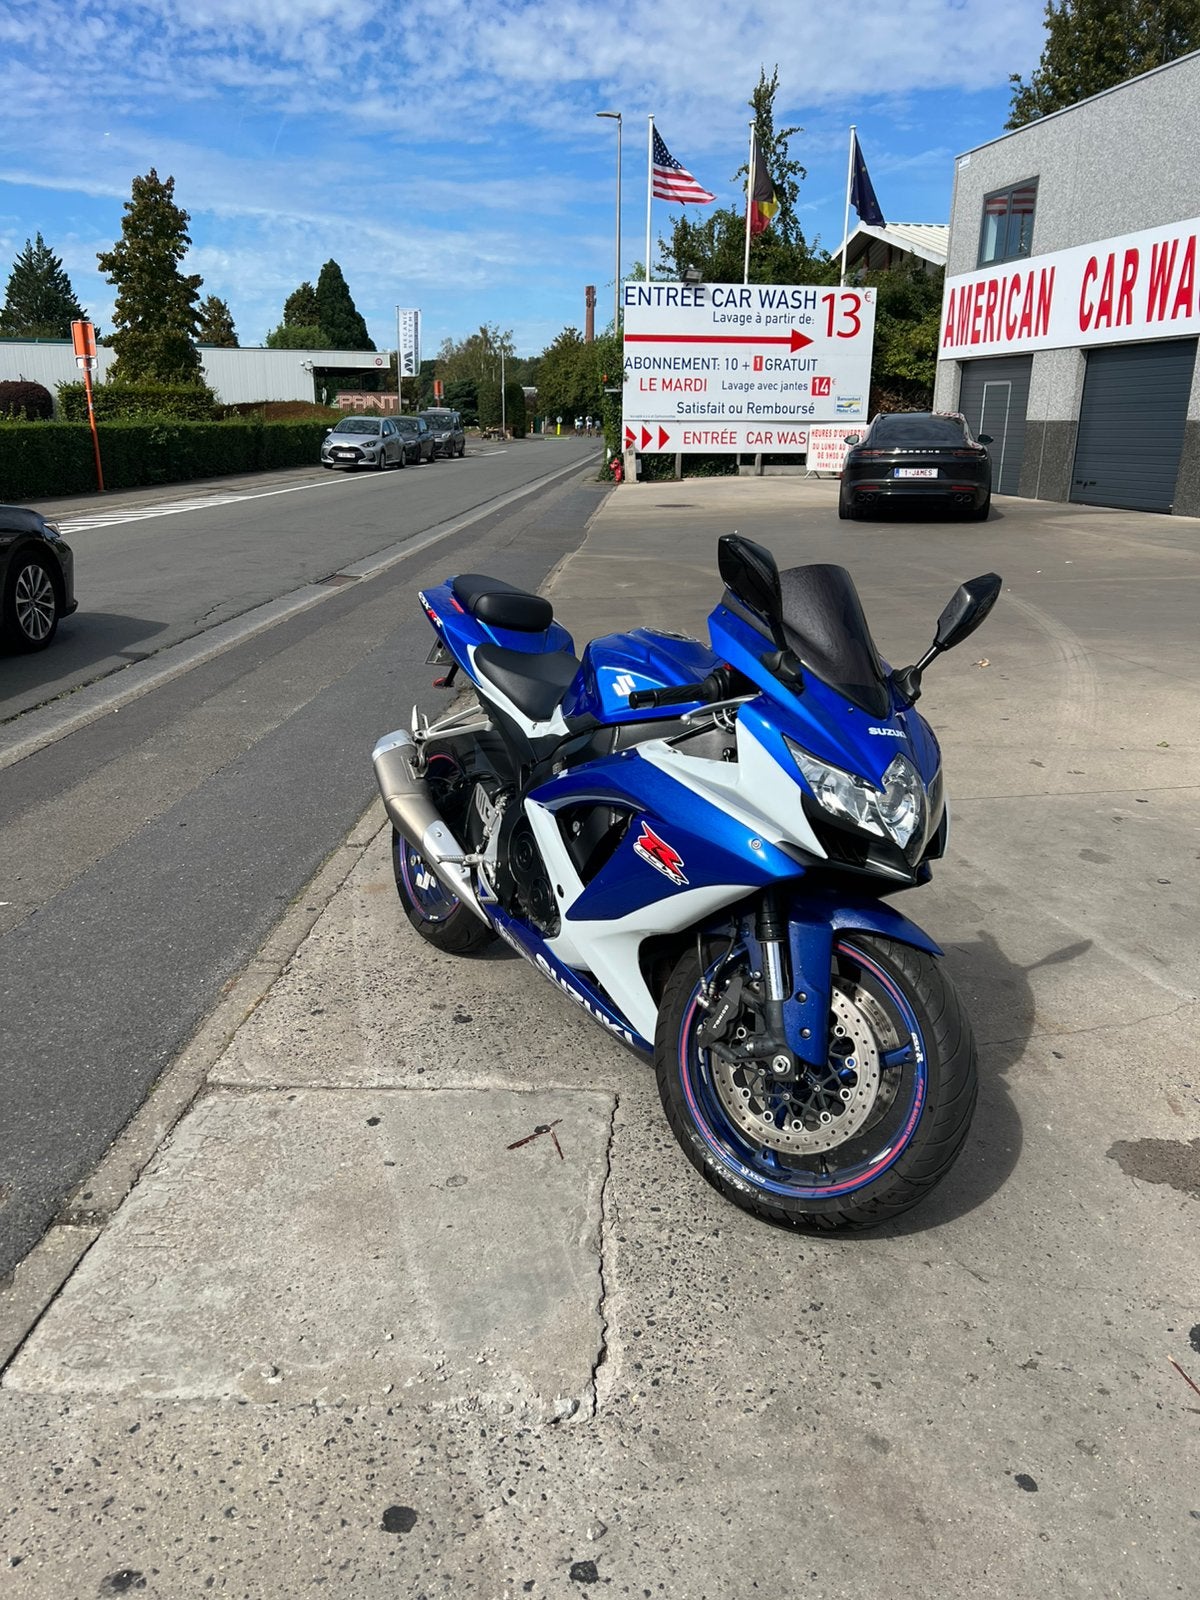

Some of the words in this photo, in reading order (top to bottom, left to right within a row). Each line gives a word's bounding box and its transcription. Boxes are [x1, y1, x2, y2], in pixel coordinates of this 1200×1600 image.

[624, 284, 705, 307] ENTRÉE
[711, 288, 751, 308] CAR
[759, 290, 817, 310] WASH
[943, 266, 1056, 348] AMERICAN
[1079, 248, 1139, 332] CAR
[1146, 235, 1200, 323] WA
[713, 312, 752, 325] Lavage
[755, 312, 762, 324] à
[765, 313, 796, 327] partir
[799, 313, 815, 325] de:
[624, 357, 720, 371] ABONNEMENT:
[725, 358, 738, 371] 10
[742, 362, 750, 370] +
[765, 359, 818, 372] GRATUIT
[640, 378, 657, 391] LE
[662, 378, 707, 392] MARDI
[722, 381, 755, 392] Lavage
[757, 383, 777, 391] avec
[780, 381, 808, 392] jantes
[676, 402, 725, 414] Satisfait
[728, 405, 743, 414] ou
[747, 401, 815, 415] Remboursé
[684, 428, 737, 445] ENTRÉE
[747, 432, 772, 445] CAR
[777, 432, 807, 445] WAS
